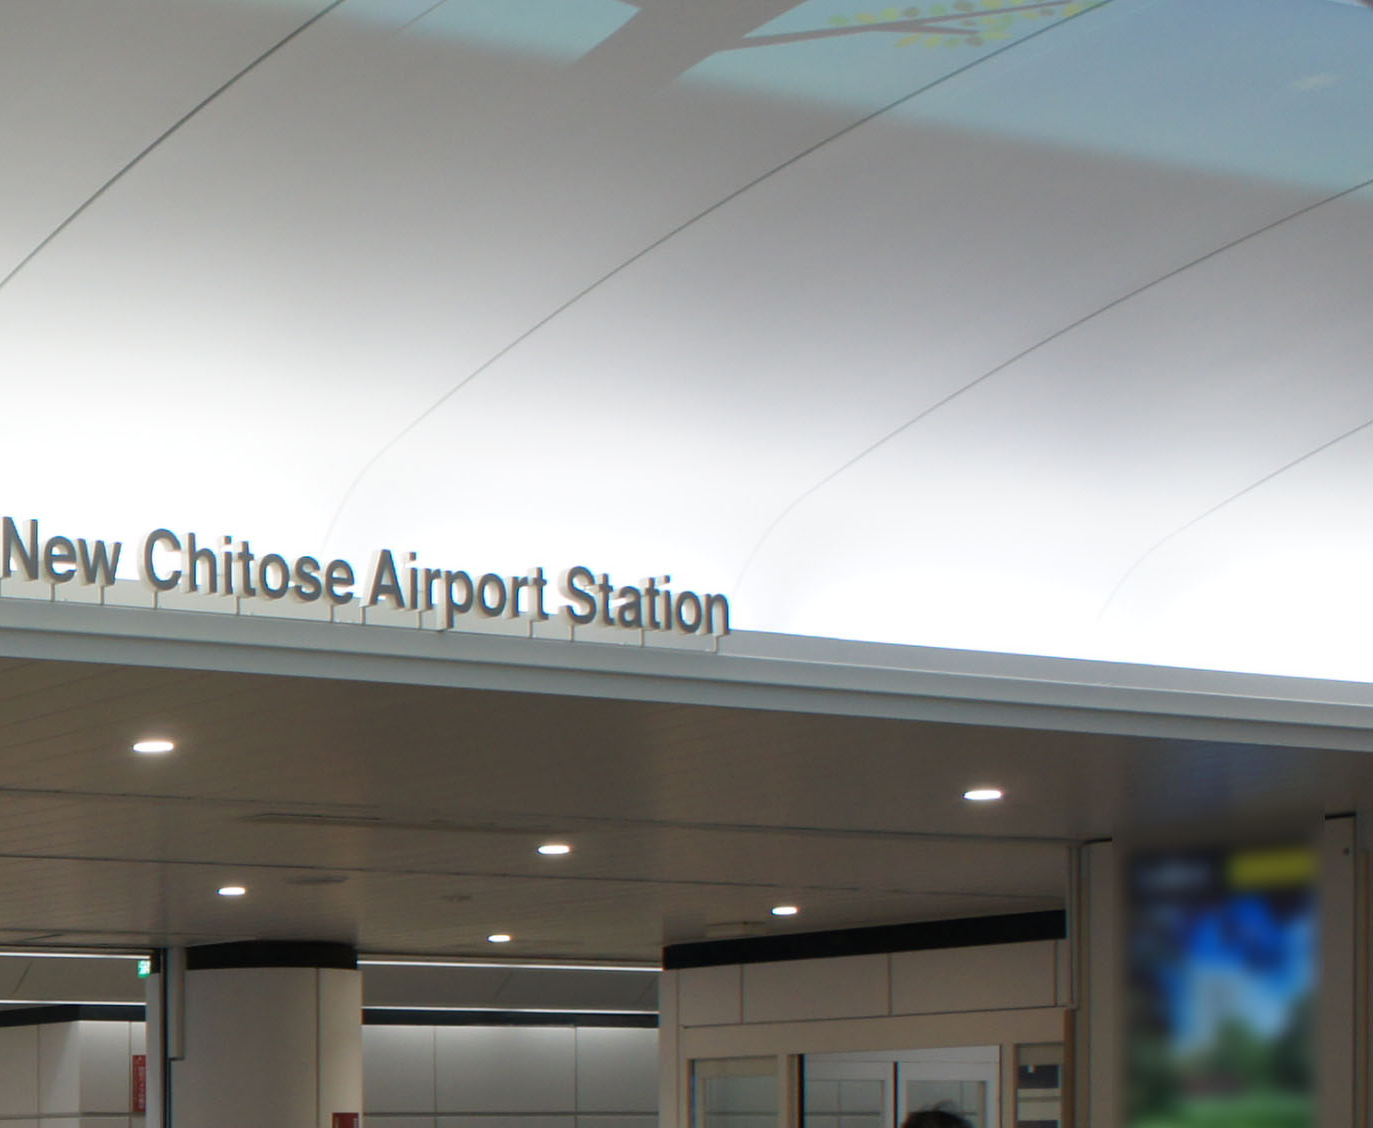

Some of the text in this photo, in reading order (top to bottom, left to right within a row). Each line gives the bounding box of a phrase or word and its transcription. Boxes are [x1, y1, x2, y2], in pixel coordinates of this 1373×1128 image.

[140, 528, 355, 606] Chitose
[362, 549, 548, 630] Airport
[559, 566, 730, 636] Station
